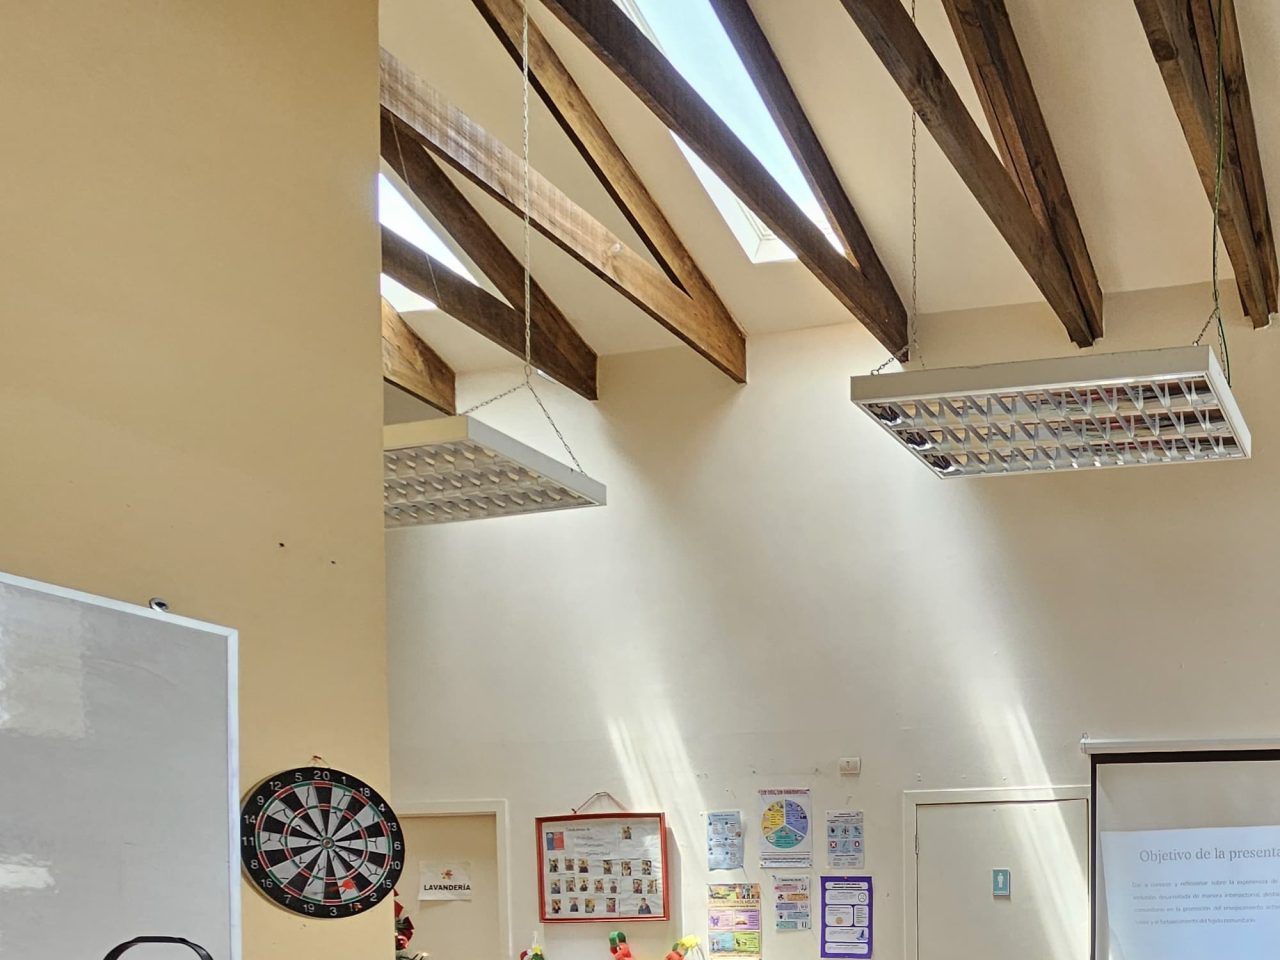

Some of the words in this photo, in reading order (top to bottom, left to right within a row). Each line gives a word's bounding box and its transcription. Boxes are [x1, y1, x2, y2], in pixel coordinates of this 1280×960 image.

[295, 772, 303, 782] 5
[313, 770, 331, 780] 20
[341, 776, 347, 784] 1
[269, 781, 282, 791] 12
[359, 787, 371, 797] 18
[256, 795, 265, 806] 9
[378, 803, 386, 812] 4
[244, 815, 256, 824] 14
[387, 822, 398, 831] 13
[242, 836, 255, 846] 11
[394, 841, 401, 850] 6
[1138, 848, 1192, 864] Objetivo
[1195, 847, 1211, 860] de
[1214, 847, 1226, 860] la
[250, 859, 259, 870] 8
[390, 861, 401, 870] 10
[261, 879, 273, 888] 16
[382, 879, 393, 889] 15
[423, 883, 471, 891] LAVANDERÍA
[283, 894, 292, 904] 7
[369, 892, 378, 901] 2
[303, 903, 315, 913] 19
[329, 907, 338, 916] 3
